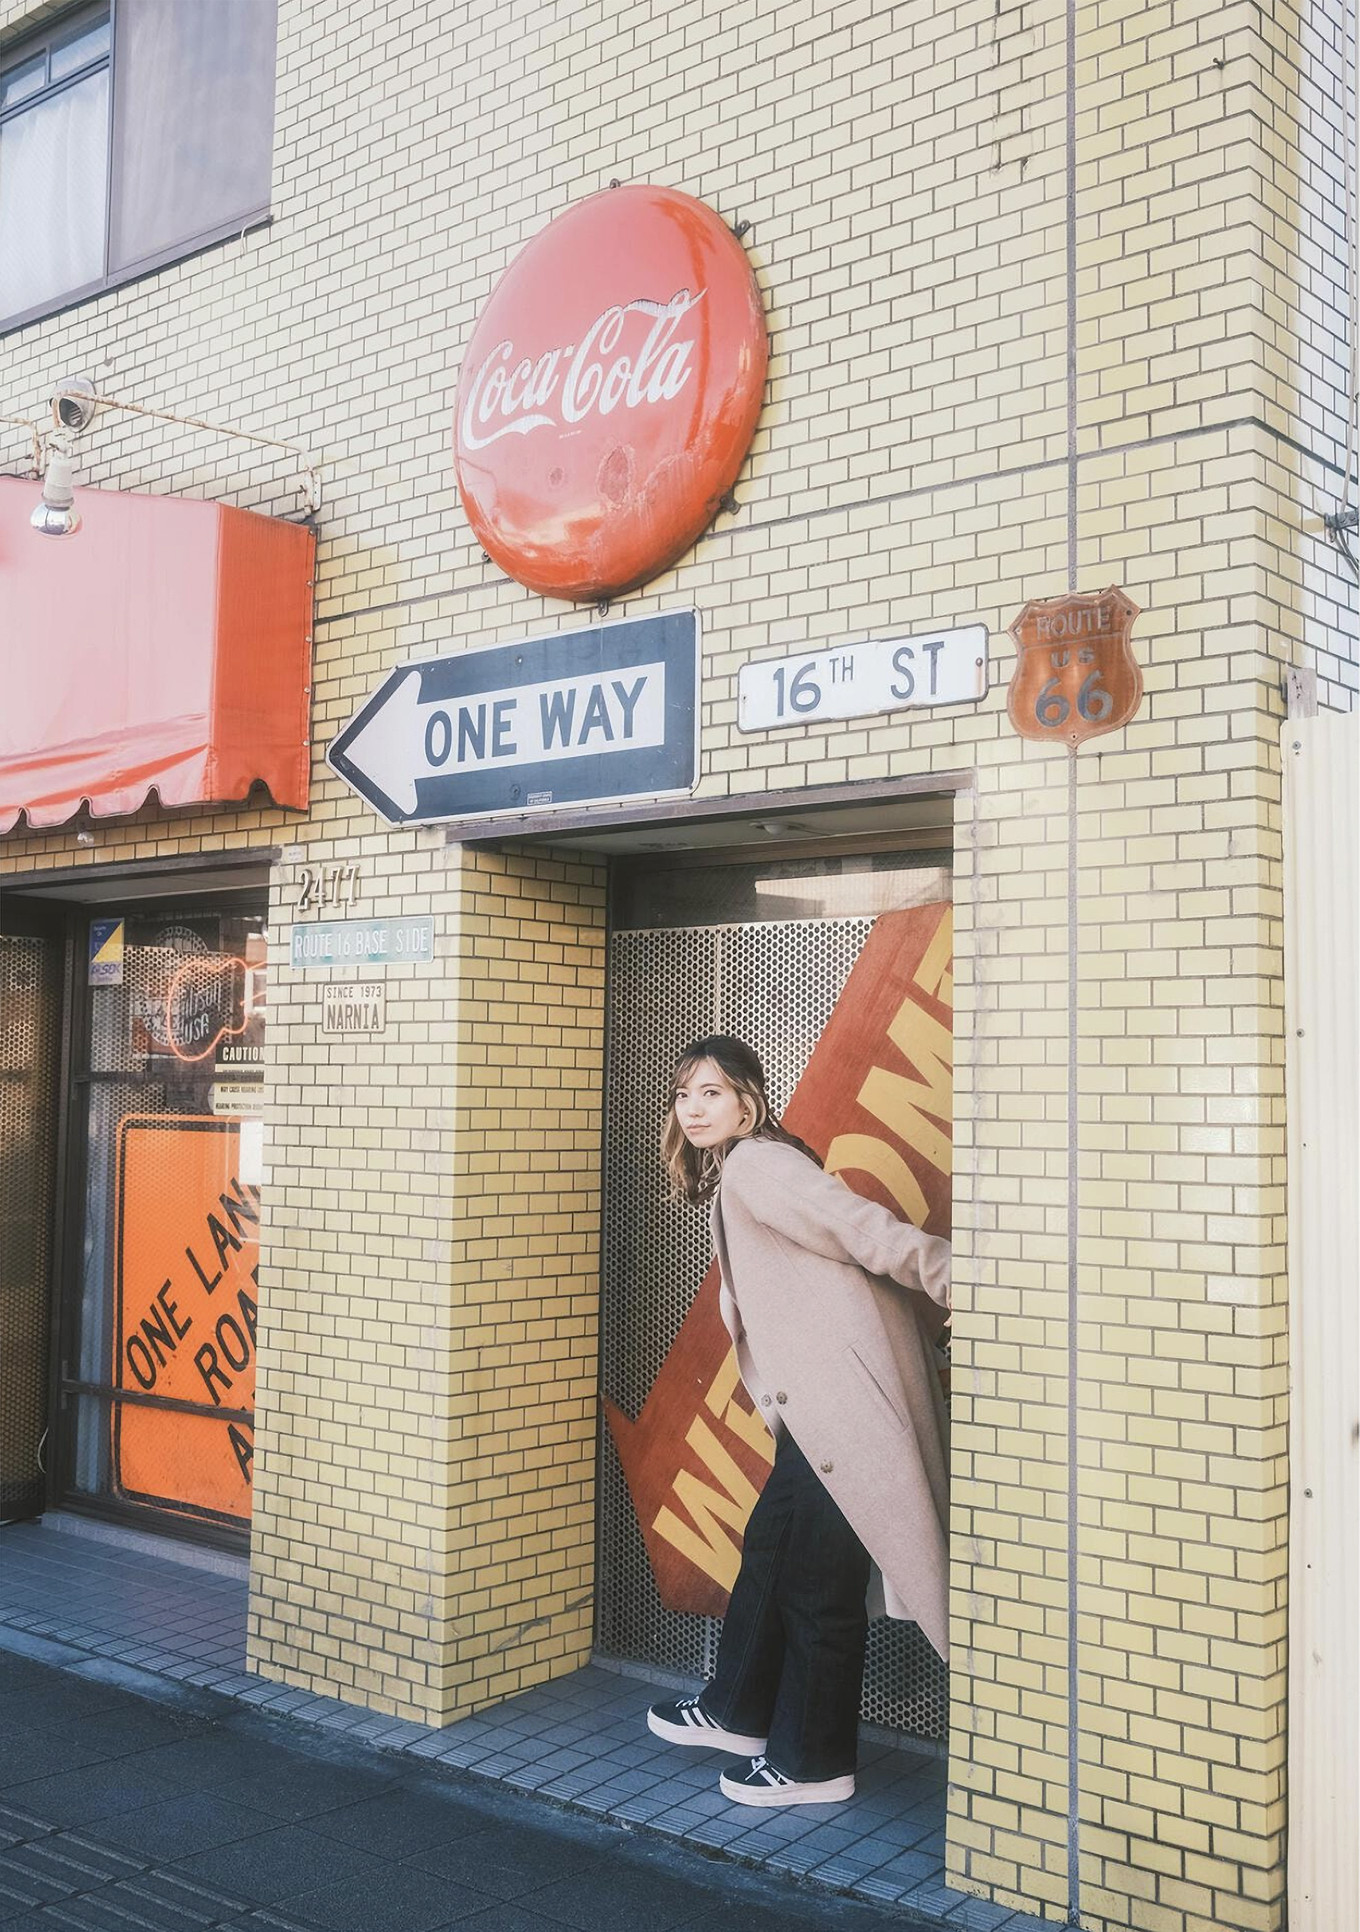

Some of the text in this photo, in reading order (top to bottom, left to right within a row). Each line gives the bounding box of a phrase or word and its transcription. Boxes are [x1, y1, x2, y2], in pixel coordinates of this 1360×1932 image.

[462, 287, 708, 450] Coca-Cola
[1037, 605, 1111, 640] ROUTE
[890, 641, 945, 700] ST
[1035, 669, 1113, 728] 66
[424, 676, 648, 768] ONE WAY
[298, 864, 360, 912] 2477
[294, 927, 428, 958] ROUTE 16 BASE SIDE
[327, 985, 382, 999] SINCE 1973
[327, 1003, 380, 1030] NARNIA
[126, 1177, 260, 1391] ONE LAN
[193, 1264, 258, 1406] ROA
